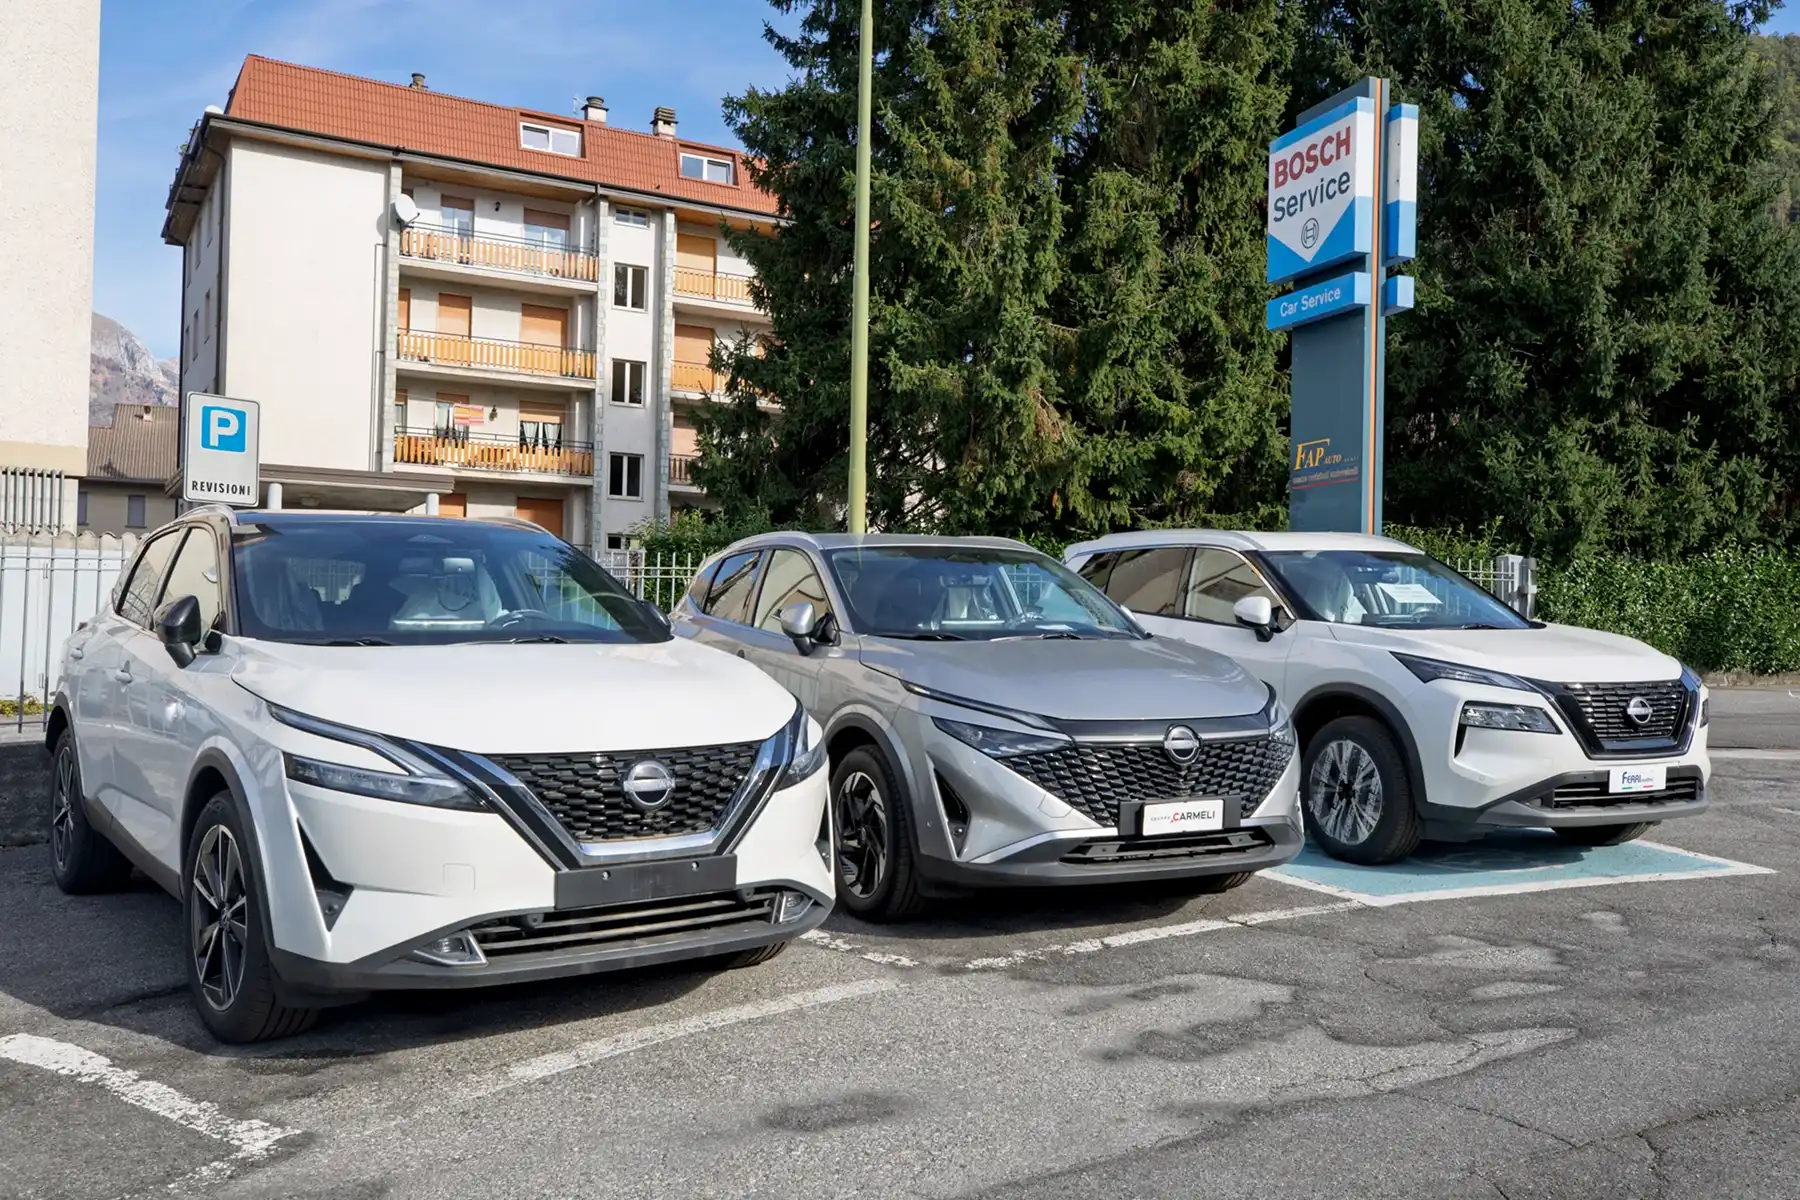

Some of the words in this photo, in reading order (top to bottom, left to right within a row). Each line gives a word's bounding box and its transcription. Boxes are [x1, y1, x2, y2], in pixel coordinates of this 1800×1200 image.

[1275, 126, 1351, 188] BOSCH
[1273, 171, 1350, 222] Service
[1280, 302, 1298, 317] Car
[1301, 290, 1341, 311] Service
[209, 409, 240, 447] P
[191, 480, 251, 496] REVISIONI
[1173, 810, 1216, 822] CARMELI
